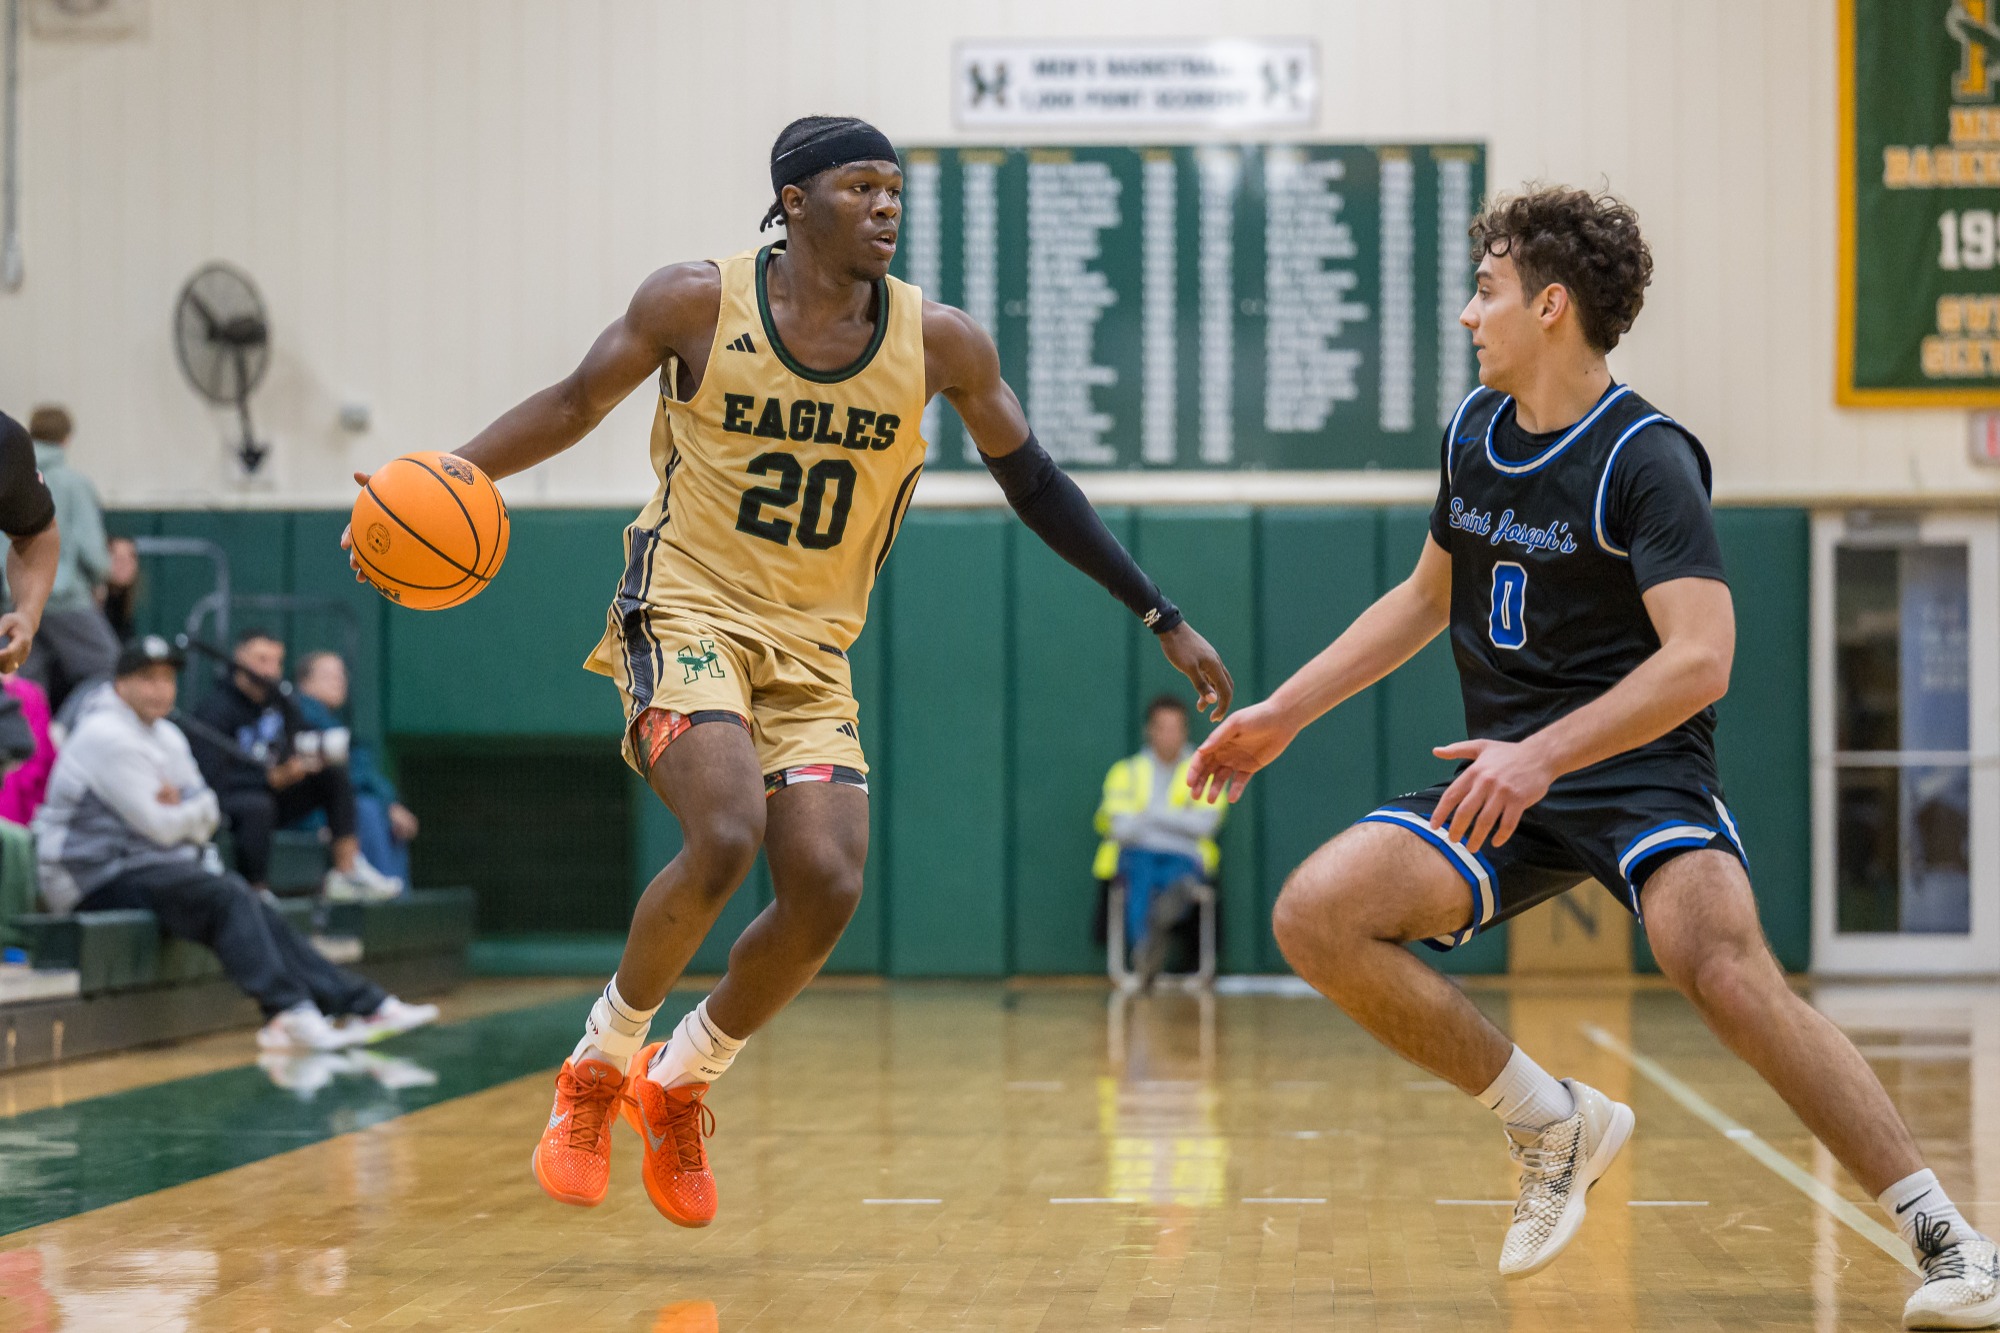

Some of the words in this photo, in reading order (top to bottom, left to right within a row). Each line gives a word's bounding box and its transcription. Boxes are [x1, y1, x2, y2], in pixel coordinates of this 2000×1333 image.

[1937, 208, 2000, 270] 19
[722, 392, 901, 452] EAGLES
[735, 452, 857, 551] 20
[1449, 497, 1491, 536] Saint
[1490, 508, 1578, 554] Joseph's
[1489, 560, 1528, 650] 0
